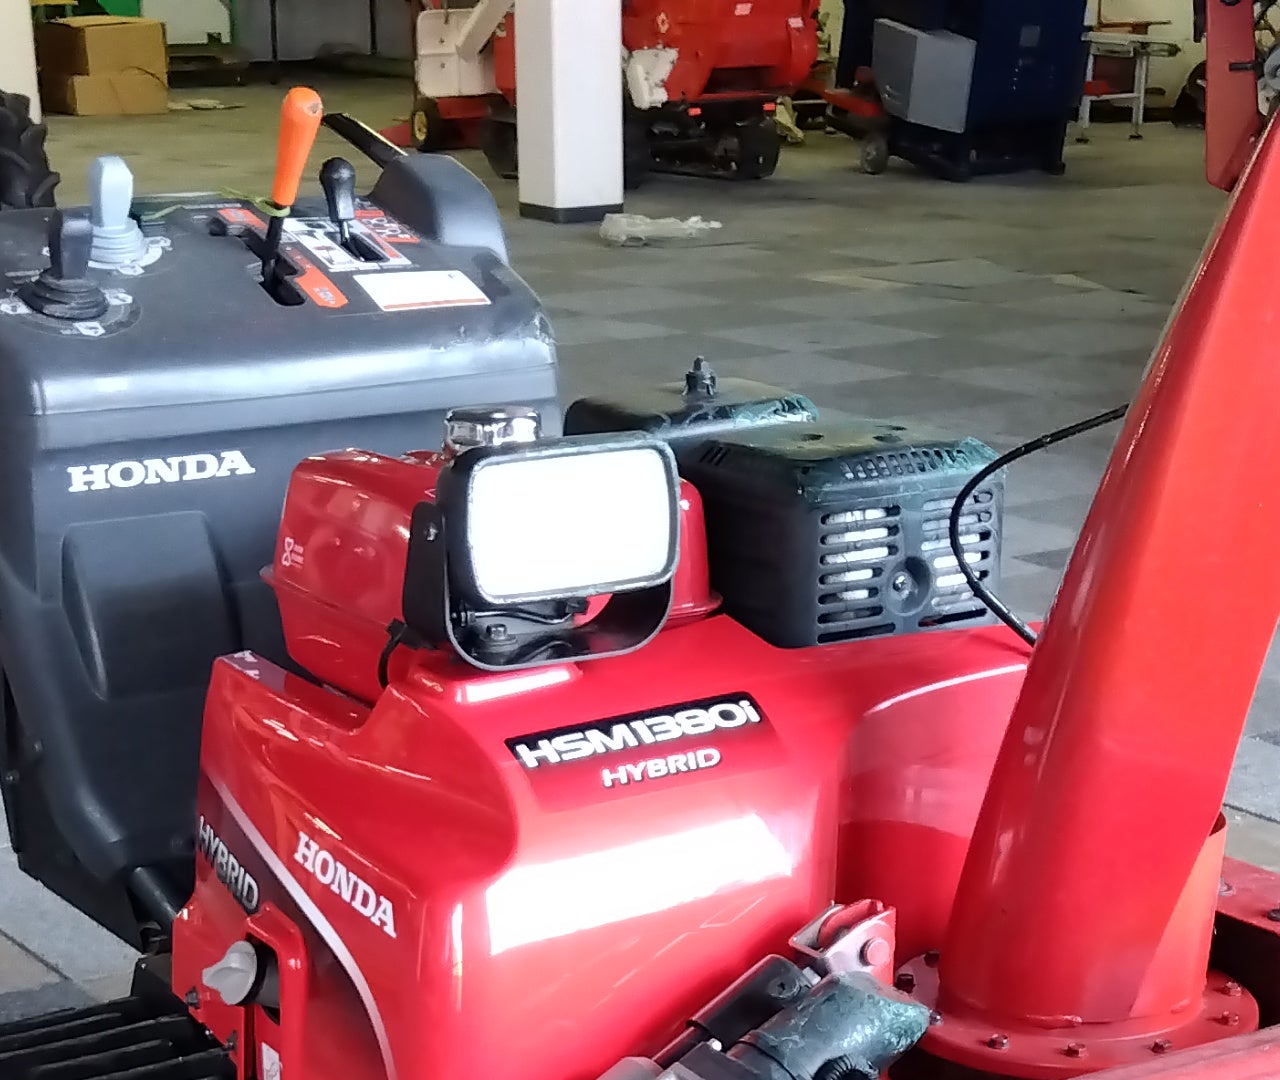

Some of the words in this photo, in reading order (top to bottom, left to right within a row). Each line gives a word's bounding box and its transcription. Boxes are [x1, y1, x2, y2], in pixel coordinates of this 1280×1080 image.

[66, 450, 257, 493] HONDA
[515, 699, 762, 769] HSM1380i
[601, 747, 722, 788] HYBRID
[199, 814, 260, 914] HYBRID
[293, 830, 398, 939] HONDA
